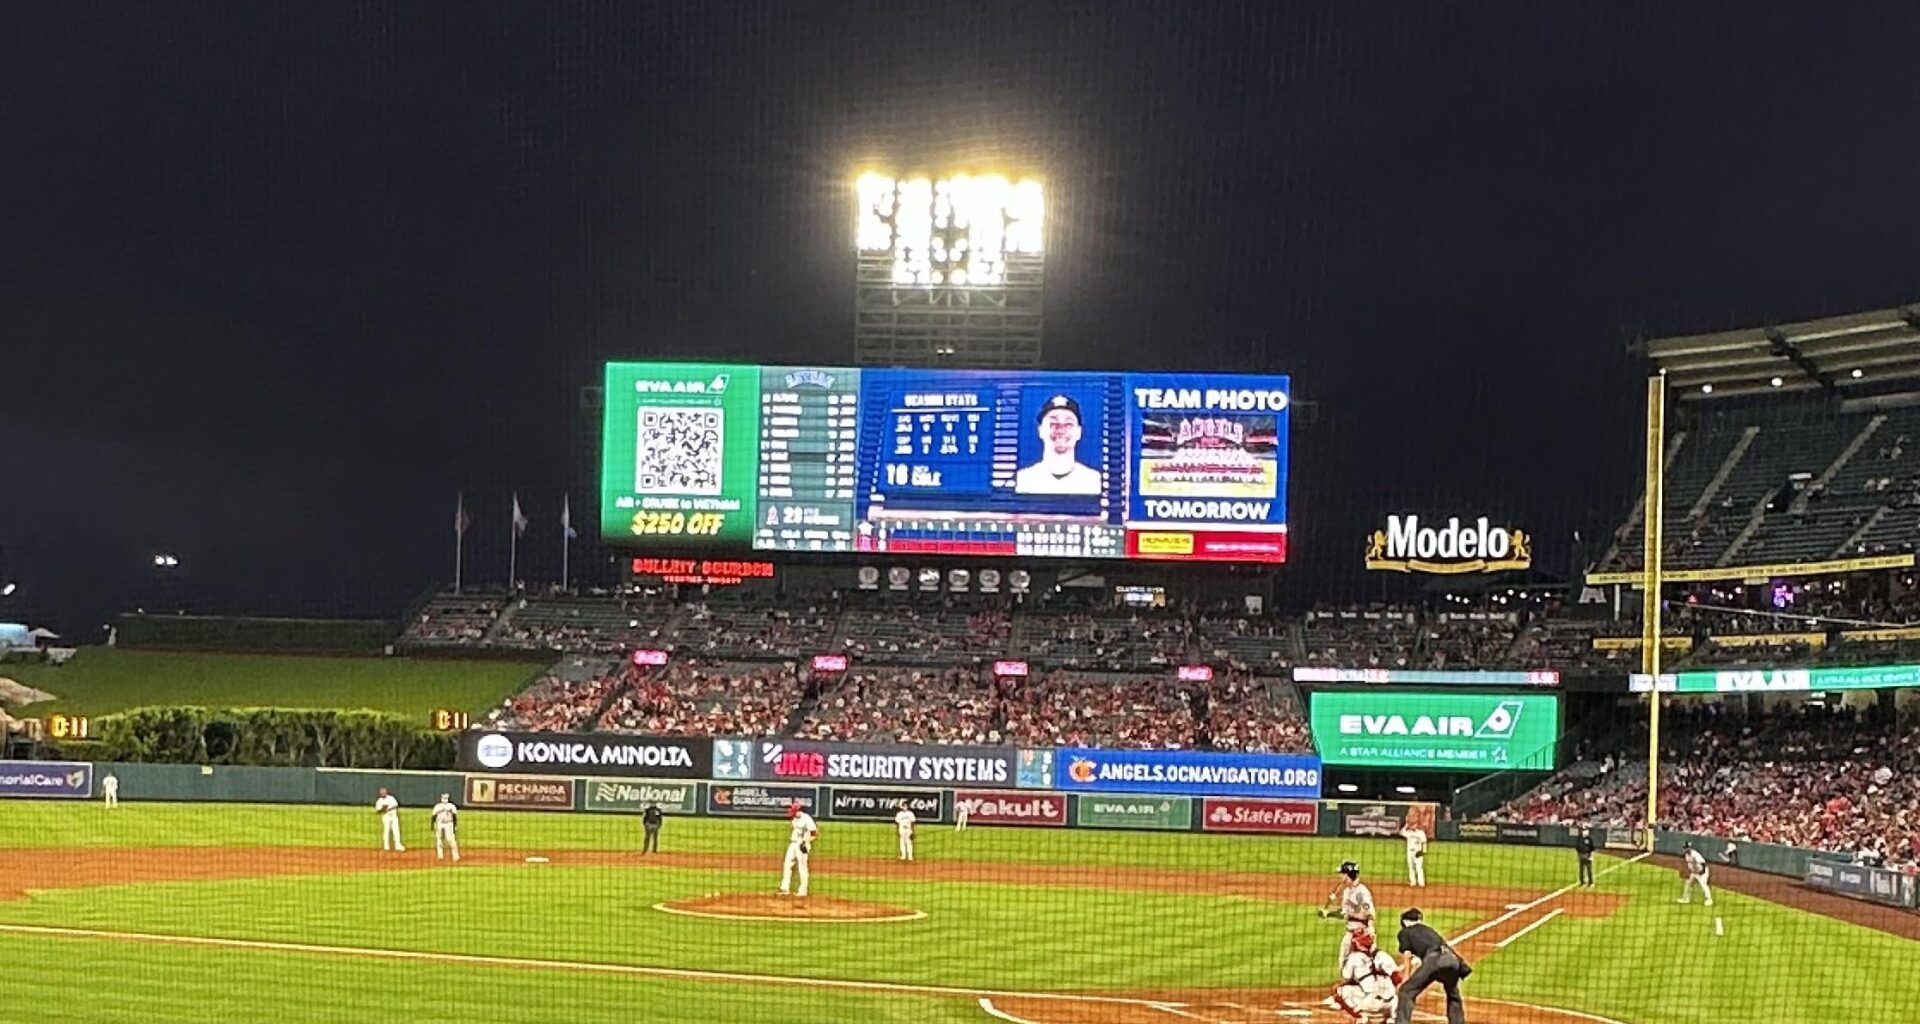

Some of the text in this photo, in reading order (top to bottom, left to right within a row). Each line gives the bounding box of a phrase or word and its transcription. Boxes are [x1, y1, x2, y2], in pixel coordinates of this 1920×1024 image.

[1134, 388, 1288, 410] TEAM PHOTO
[1145, 500, 1271, 519] TOMORROW
[631, 510, 726, 535] $250 OFF
[1387, 515, 1509, 558] Modelo
[51, 714, 88, 738] 0:11
[438, 710, 468, 730] 0:11
[1339, 715, 1474, 737] EVA AIR
[518, 742, 599, 764] KONICA
[601, 745, 693, 767] MINOLTA
[1340, 748, 1487, 760] A STAR ALLIANCE MEMBER
[774, 752, 824, 777] JMG
[828, 754, 915, 779] SECURITY
[918, 755, 1008, 782] SYSTEMS
[1099, 760, 1318, 788] ANGELS.OCNAVIGATOR.ORG
[499, 783, 566, 794] PECHANGA
[617, 784, 686, 802] National
[968, 798, 1059, 817] Yakult
[1094, 804, 1155, 814] EVA AIR
[1233, 806, 1313, 825] State Farm
